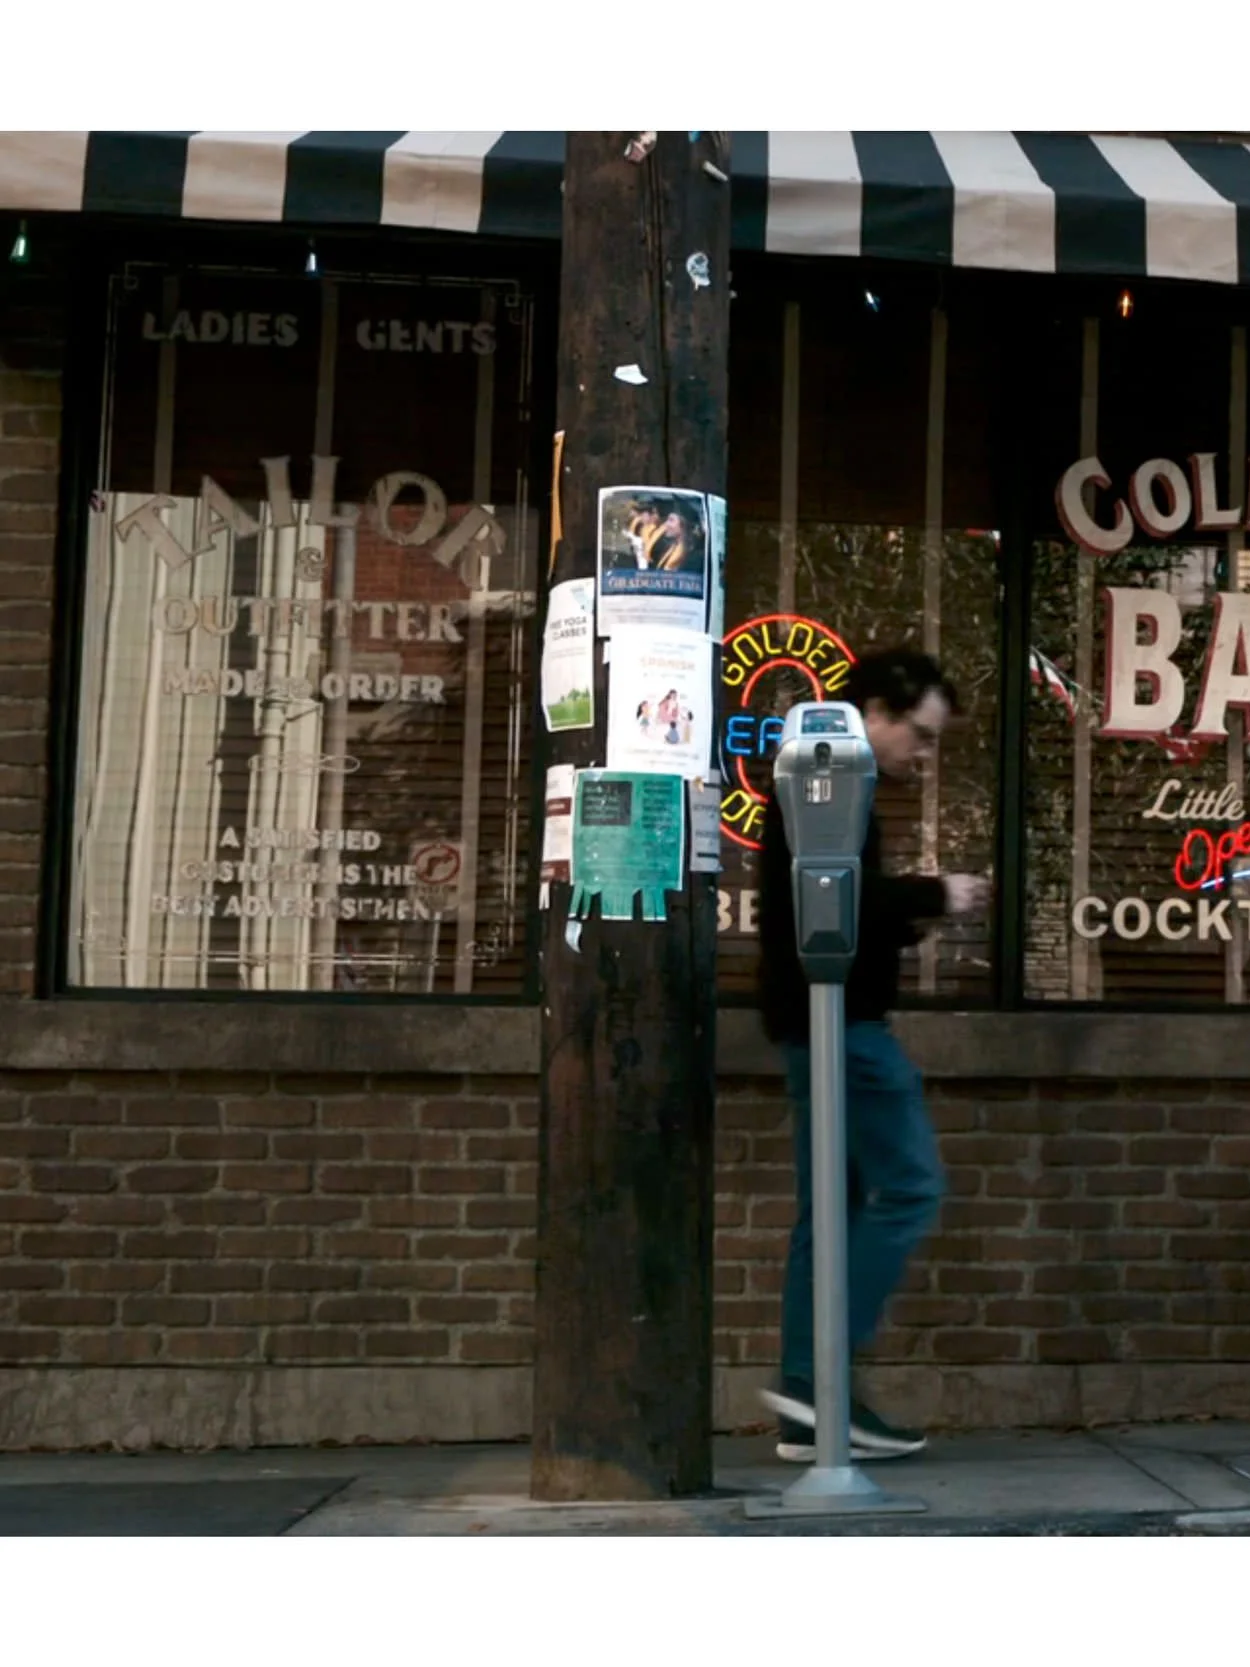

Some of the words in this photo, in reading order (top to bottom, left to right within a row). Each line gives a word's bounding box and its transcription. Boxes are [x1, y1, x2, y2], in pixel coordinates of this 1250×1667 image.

[142, 310, 299, 348] LADIES
[355, 318, 498, 356] GENTS
[114, 454, 509, 590] TAILOR
[720, 622, 850, 692] GOLDEN
[321, 671, 446, 704] ORDER
[1143, 777, 1246, 823] Little
[218, 826, 240, 849] A
[717, 889, 761, 934] BE
